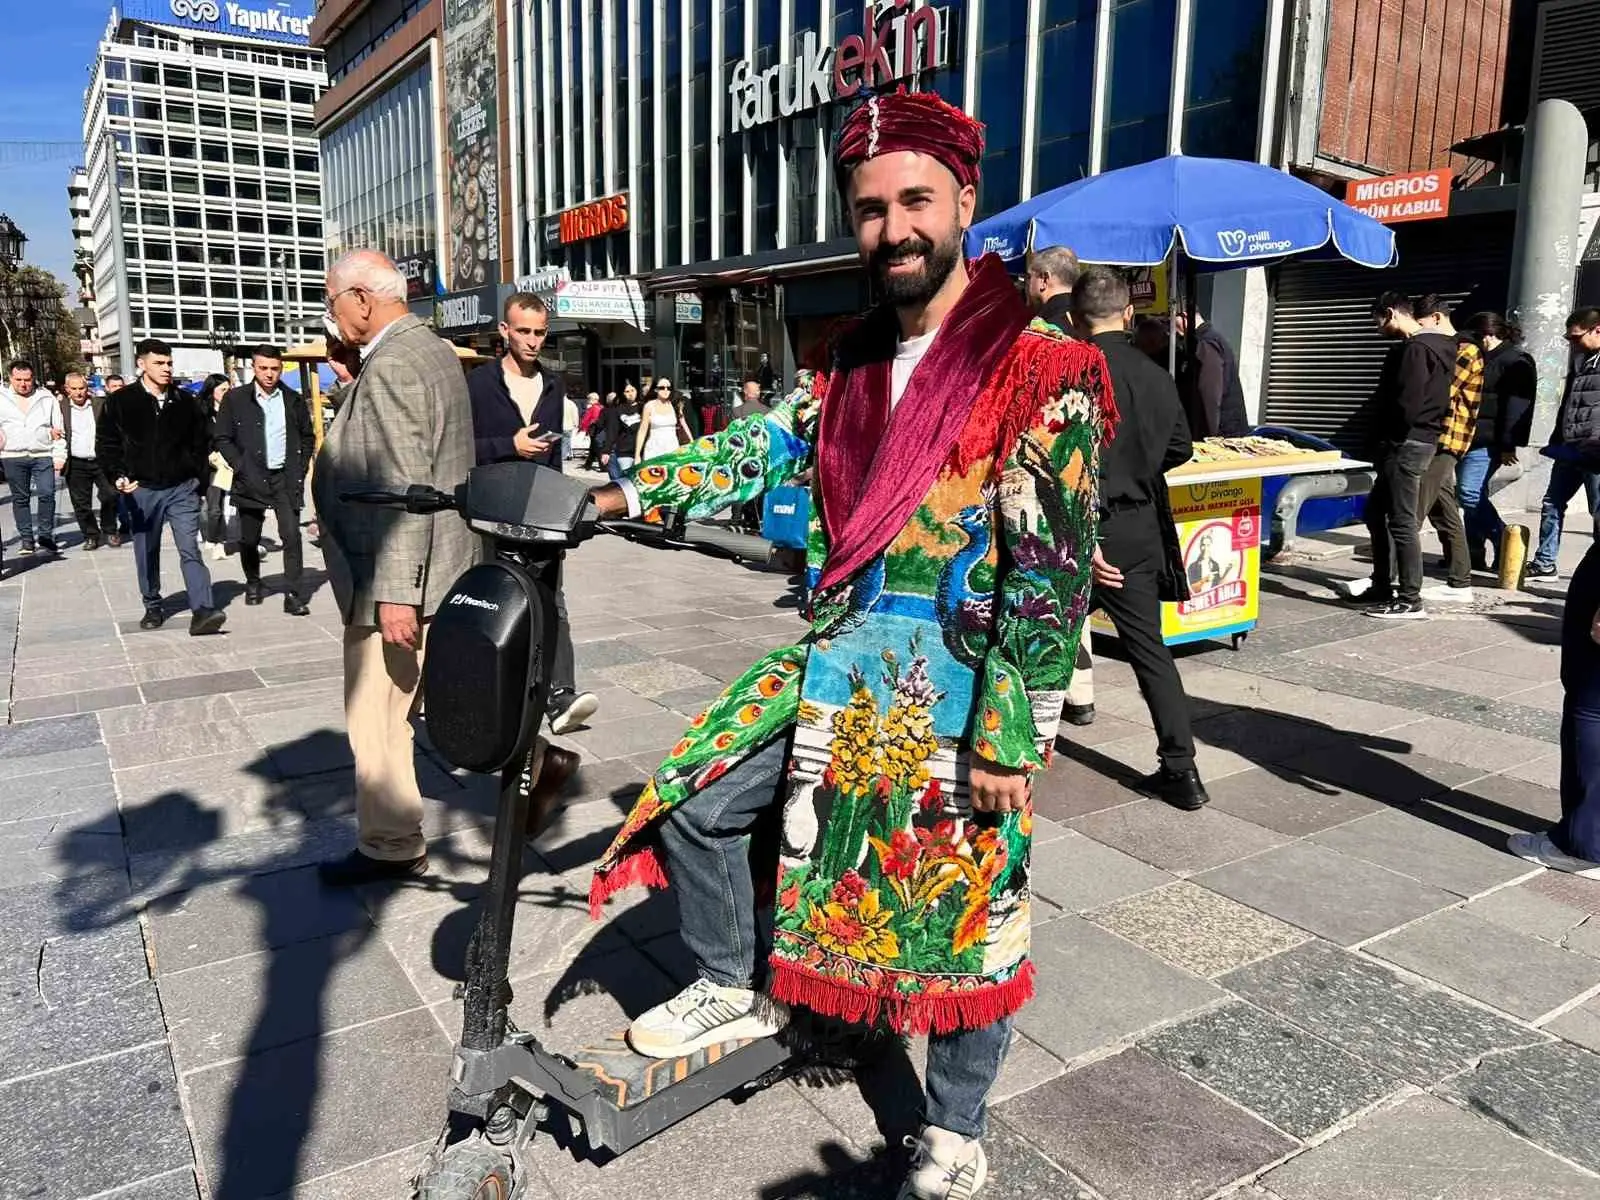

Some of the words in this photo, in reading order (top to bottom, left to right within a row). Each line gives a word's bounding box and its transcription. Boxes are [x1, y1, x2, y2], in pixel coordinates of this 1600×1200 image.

[1351, 202, 1389, 218] ÜN
[1392, 198, 1443, 217] KABUL
[773, 503, 796, 515] mavi
